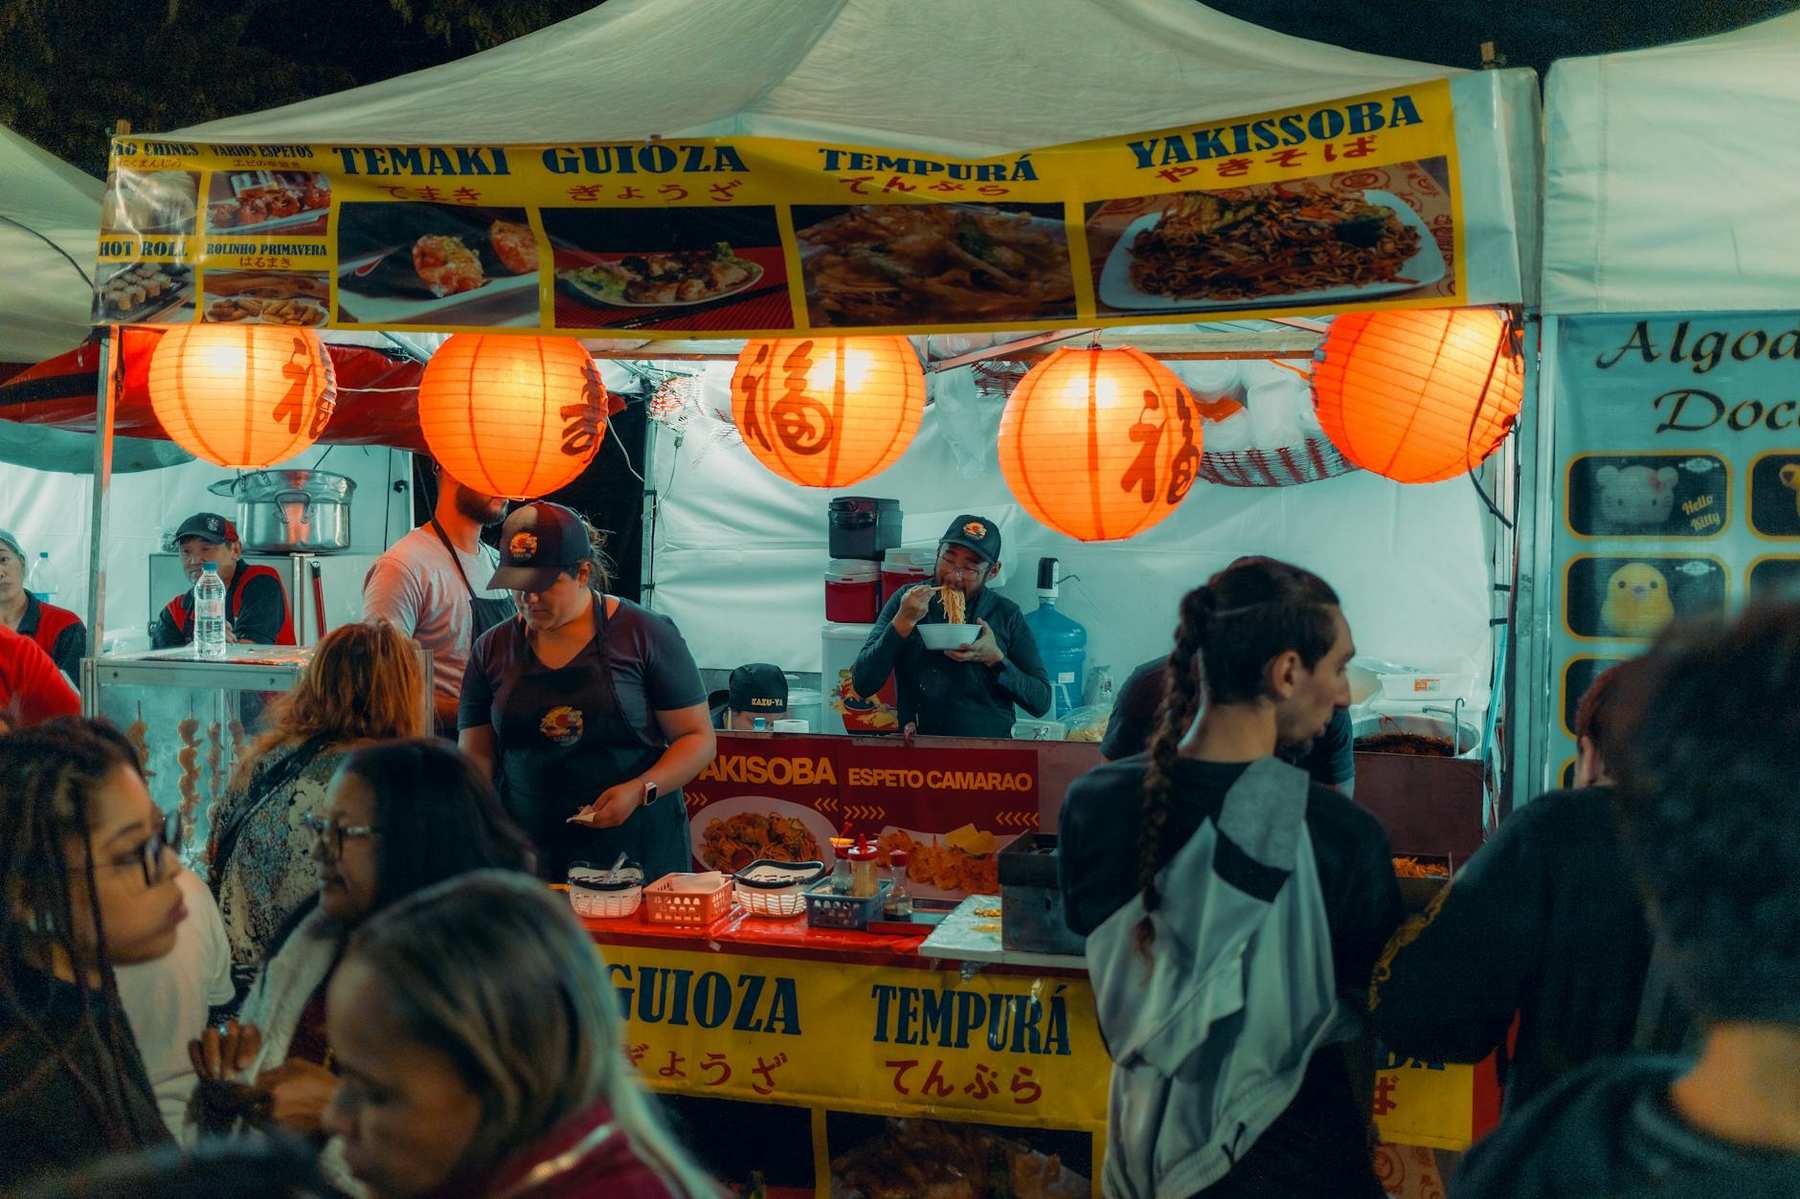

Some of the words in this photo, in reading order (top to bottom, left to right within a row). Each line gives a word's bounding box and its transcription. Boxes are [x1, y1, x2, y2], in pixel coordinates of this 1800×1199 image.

[1126, 95, 1424, 169] YAKISSOBA
[332, 147, 512, 176] TEMAKI
[542, 144, 750, 174] GUIOZA
[818, 148, 1039, 182] TEMPURÁ
[1155, 134, 1379, 184] やきそば
[376, 185, 482, 206] てまき
[568, 179, 743, 202] ぎょうざ
[98, 240, 133, 256] HOT
[142, 240, 188, 256] ROLL
[206, 243, 256, 255] ROLINHO
[260, 244, 327, 256] PRIMAVERA
[1653, 388, 1800, 434] Doc
[698, 755, 837, 786] AKISOBA
[848, 768, 924, 789] ESPETO
[926, 770, 1033, 792] CAMARAO
[606, 963, 802, 1036] GUIOZA
[872, 984, 1072, 1056] TEMPURÁ
